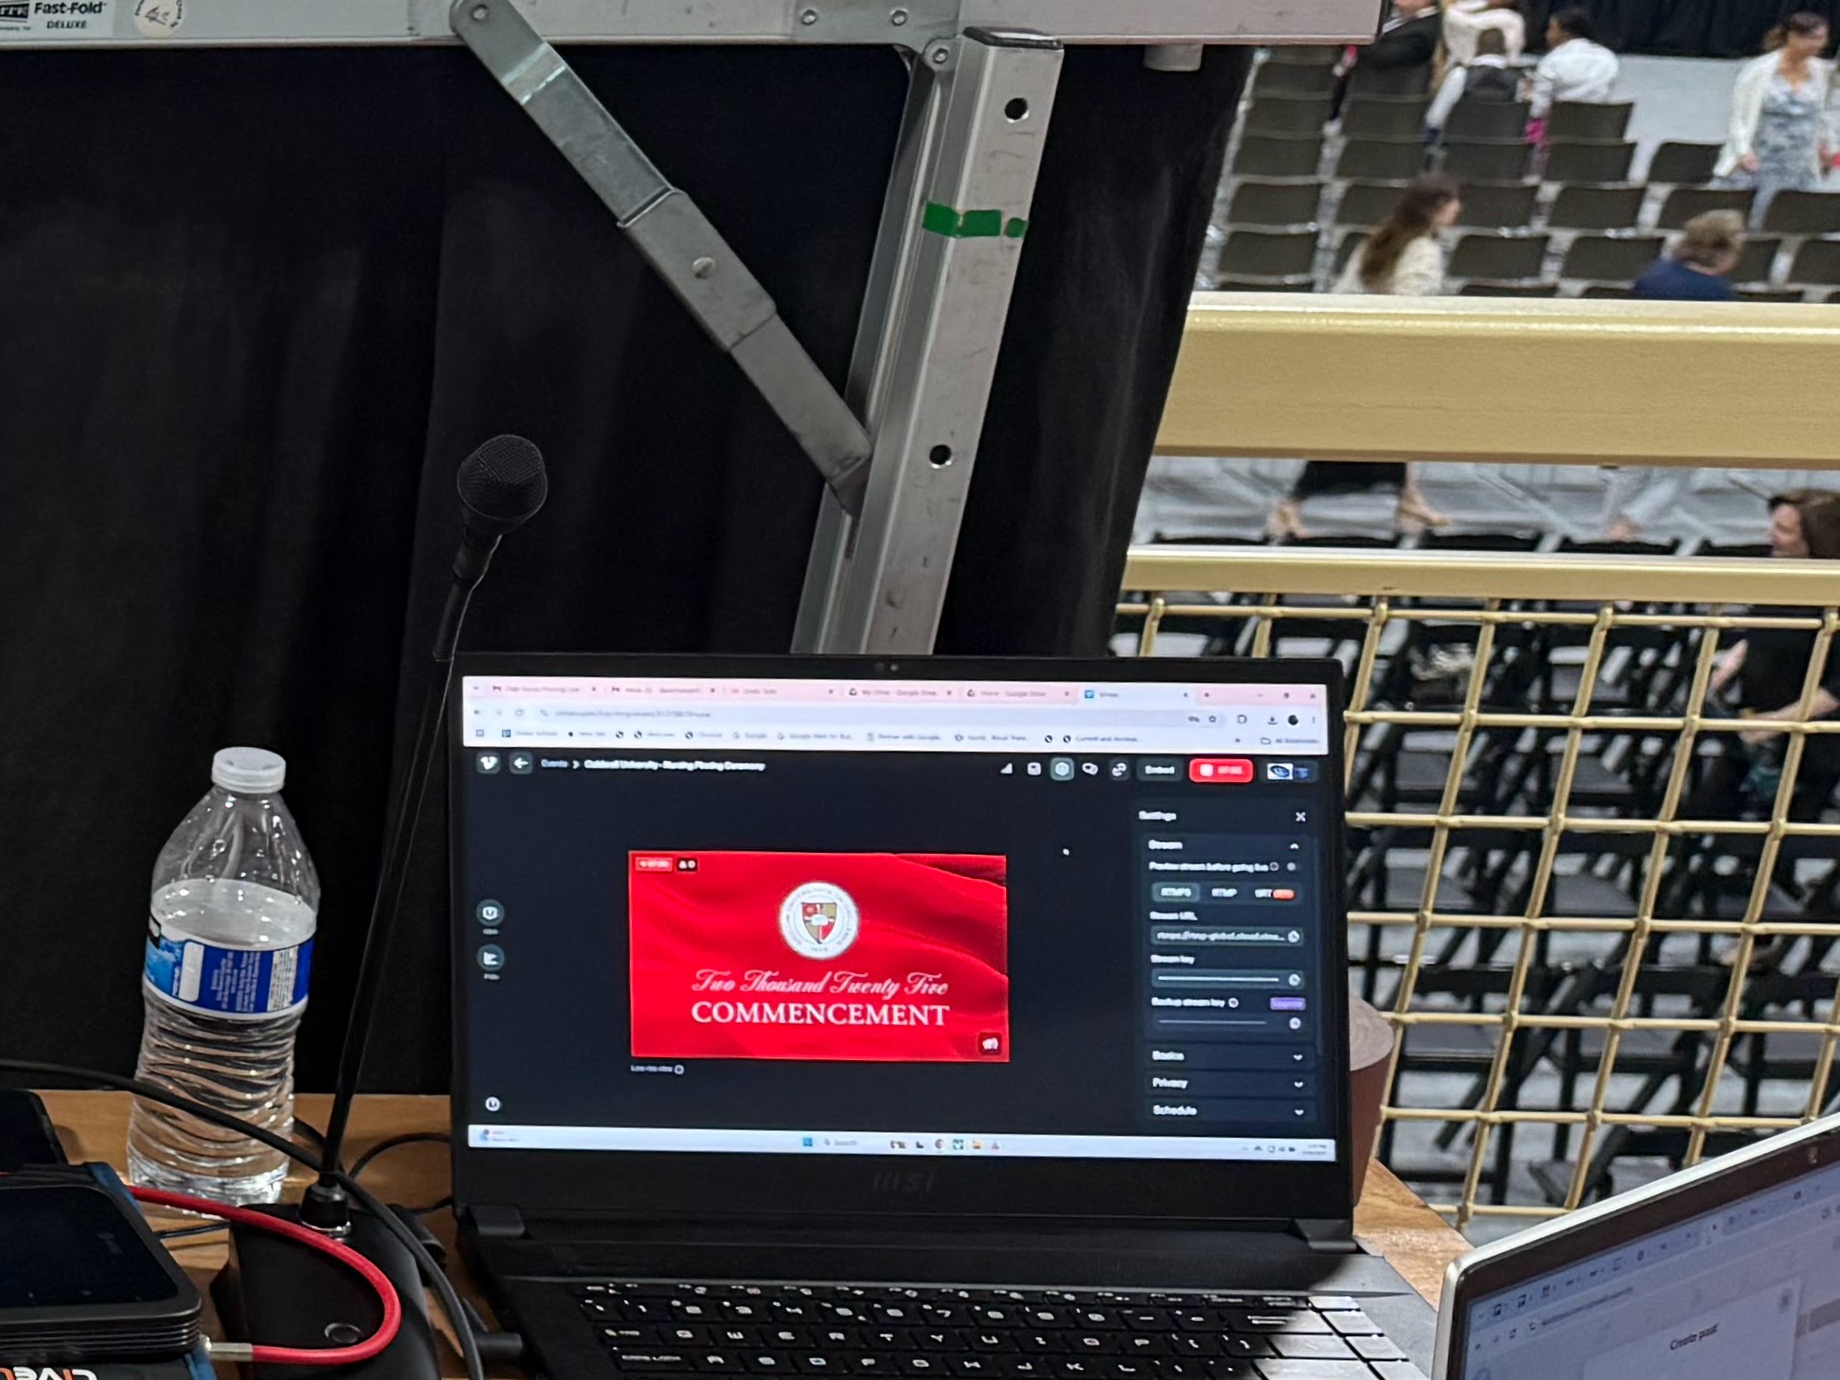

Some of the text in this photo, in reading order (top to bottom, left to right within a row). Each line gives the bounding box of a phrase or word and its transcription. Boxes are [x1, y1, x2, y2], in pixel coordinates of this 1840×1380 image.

[34, 2, 104, 14] Fast-Fold
[46, 20, 87, 29] DELUXE
[691, 969, 735, 992] Two
[741, 969, 832, 994] Thousand
[829, 971, 900, 1000] Twenty
[691, 1000, 950, 1026] COMMENCEMENT
